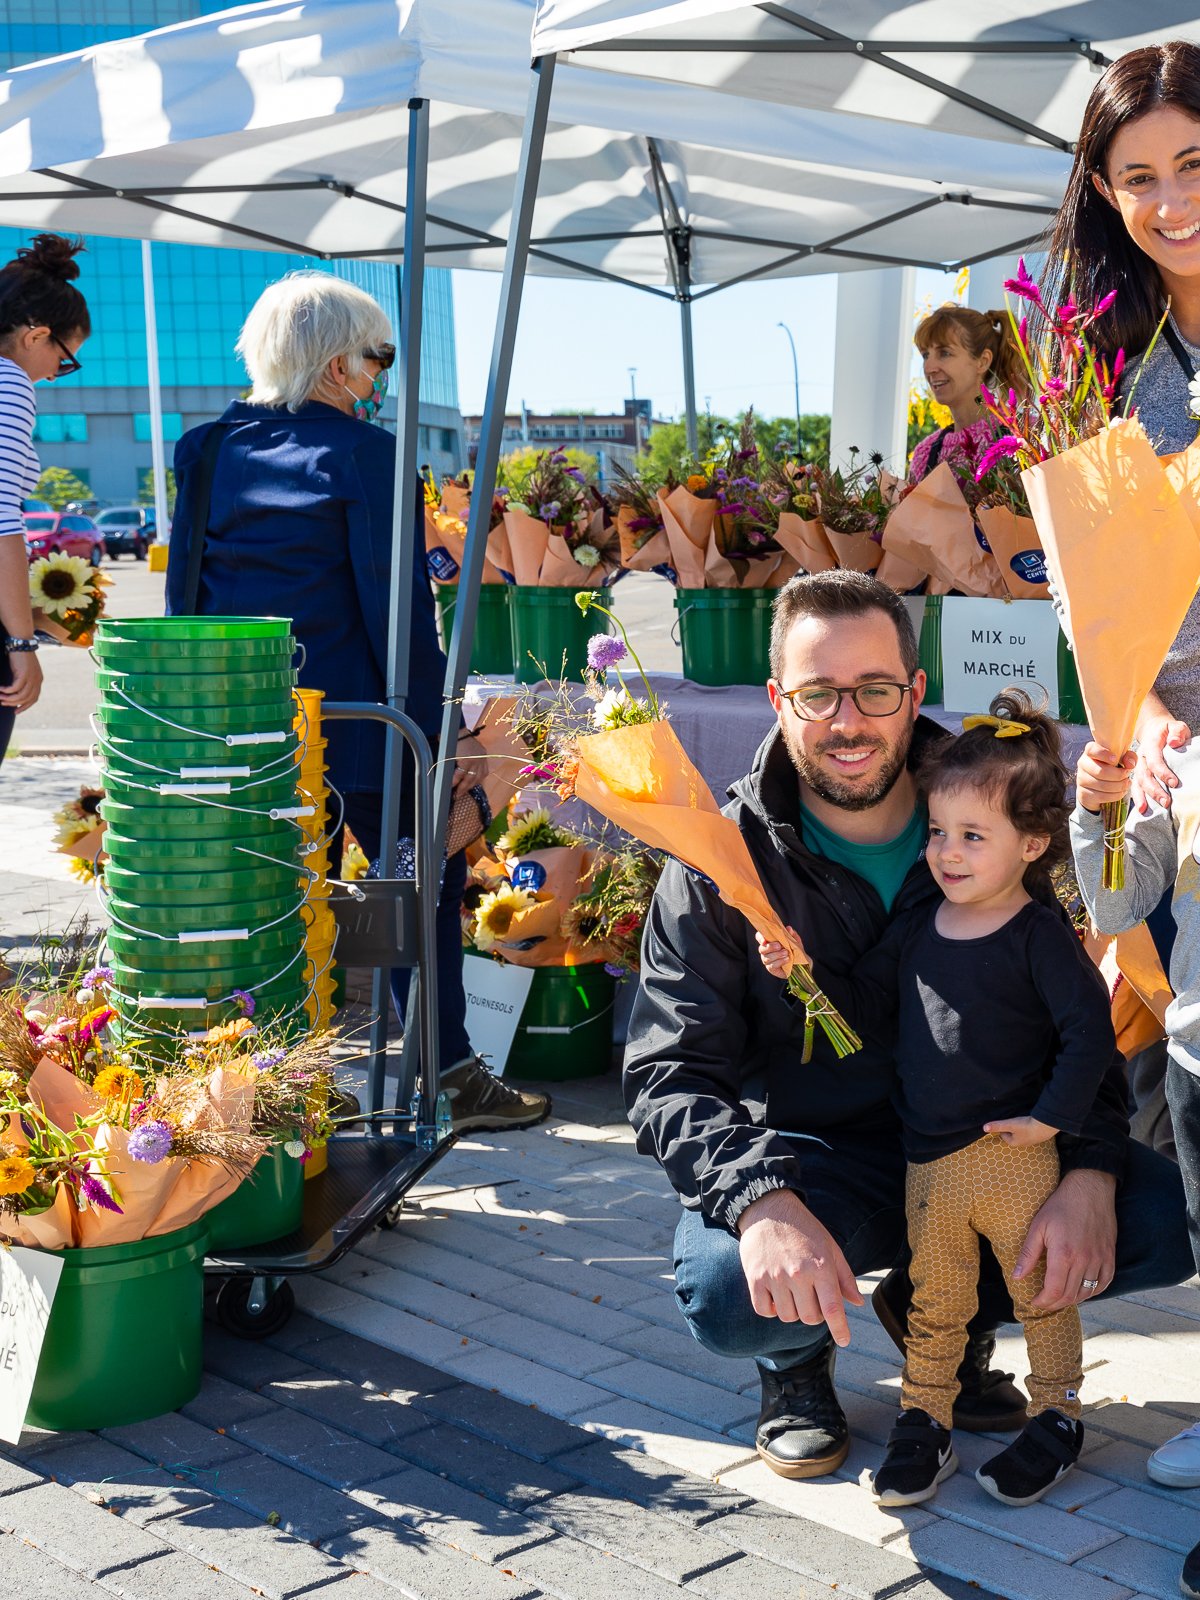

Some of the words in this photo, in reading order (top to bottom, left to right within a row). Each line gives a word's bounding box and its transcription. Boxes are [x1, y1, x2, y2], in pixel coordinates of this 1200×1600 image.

[1026, 570, 1047, 579] CENTR
[971, 630, 1002, 645] MIX
[1009, 636, 1026, 645] DU
[963, 660, 1036, 678] MARCHÉ
[467, 992, 515, 1015] TOURNESOLS
